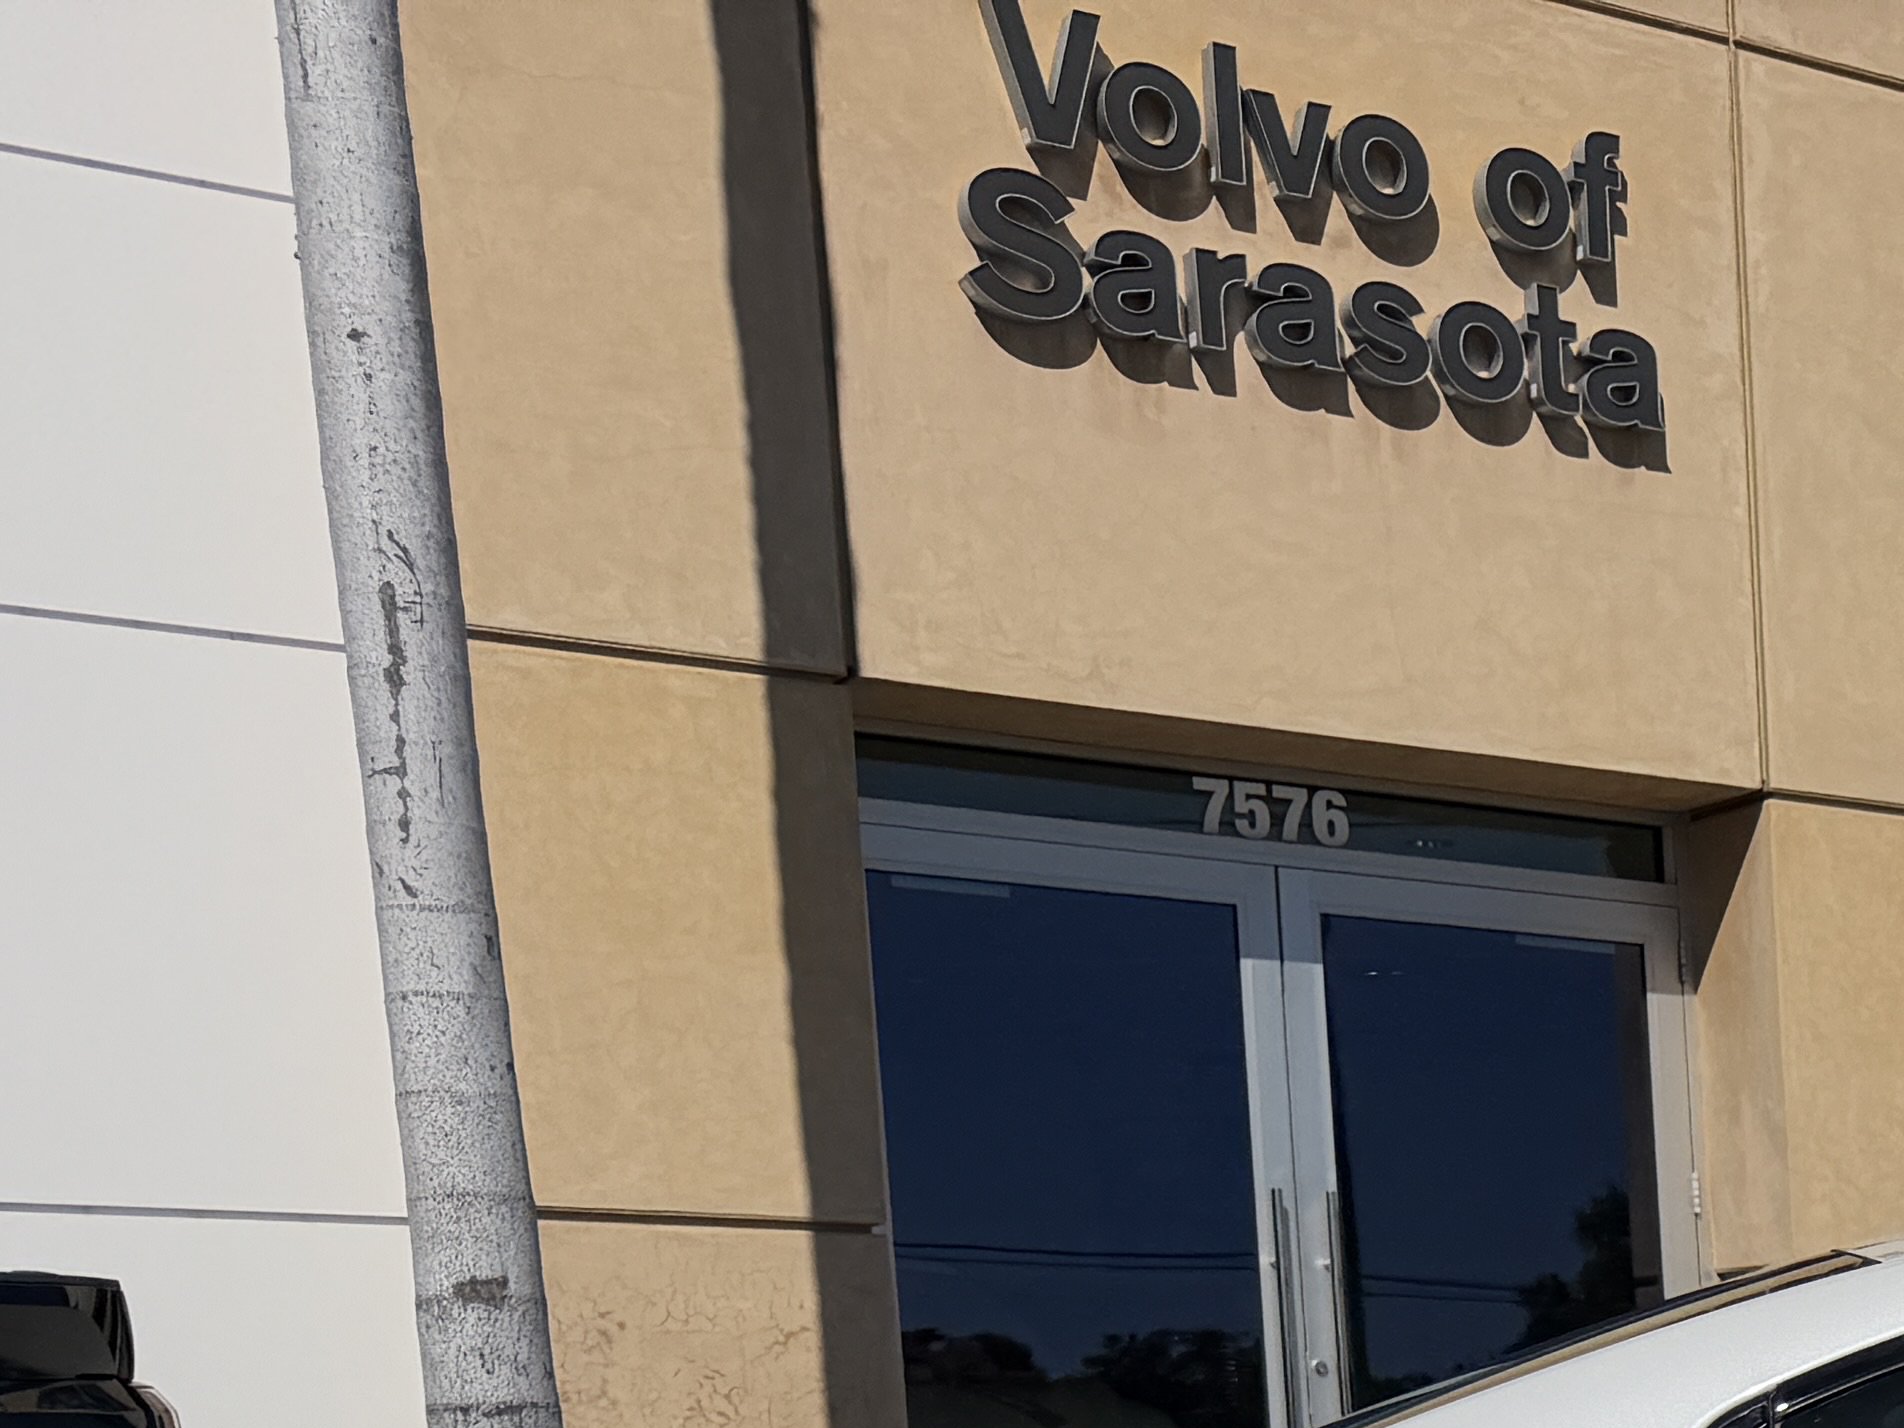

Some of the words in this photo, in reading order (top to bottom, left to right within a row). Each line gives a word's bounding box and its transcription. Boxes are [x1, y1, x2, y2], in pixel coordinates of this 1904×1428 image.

[979, 0, 1430, 220] Volvo
[1473, 131, 1624, 265] of
[959, 167, 1666, 430] Sarasota
[1192, 776, 1351, 848] 7576
